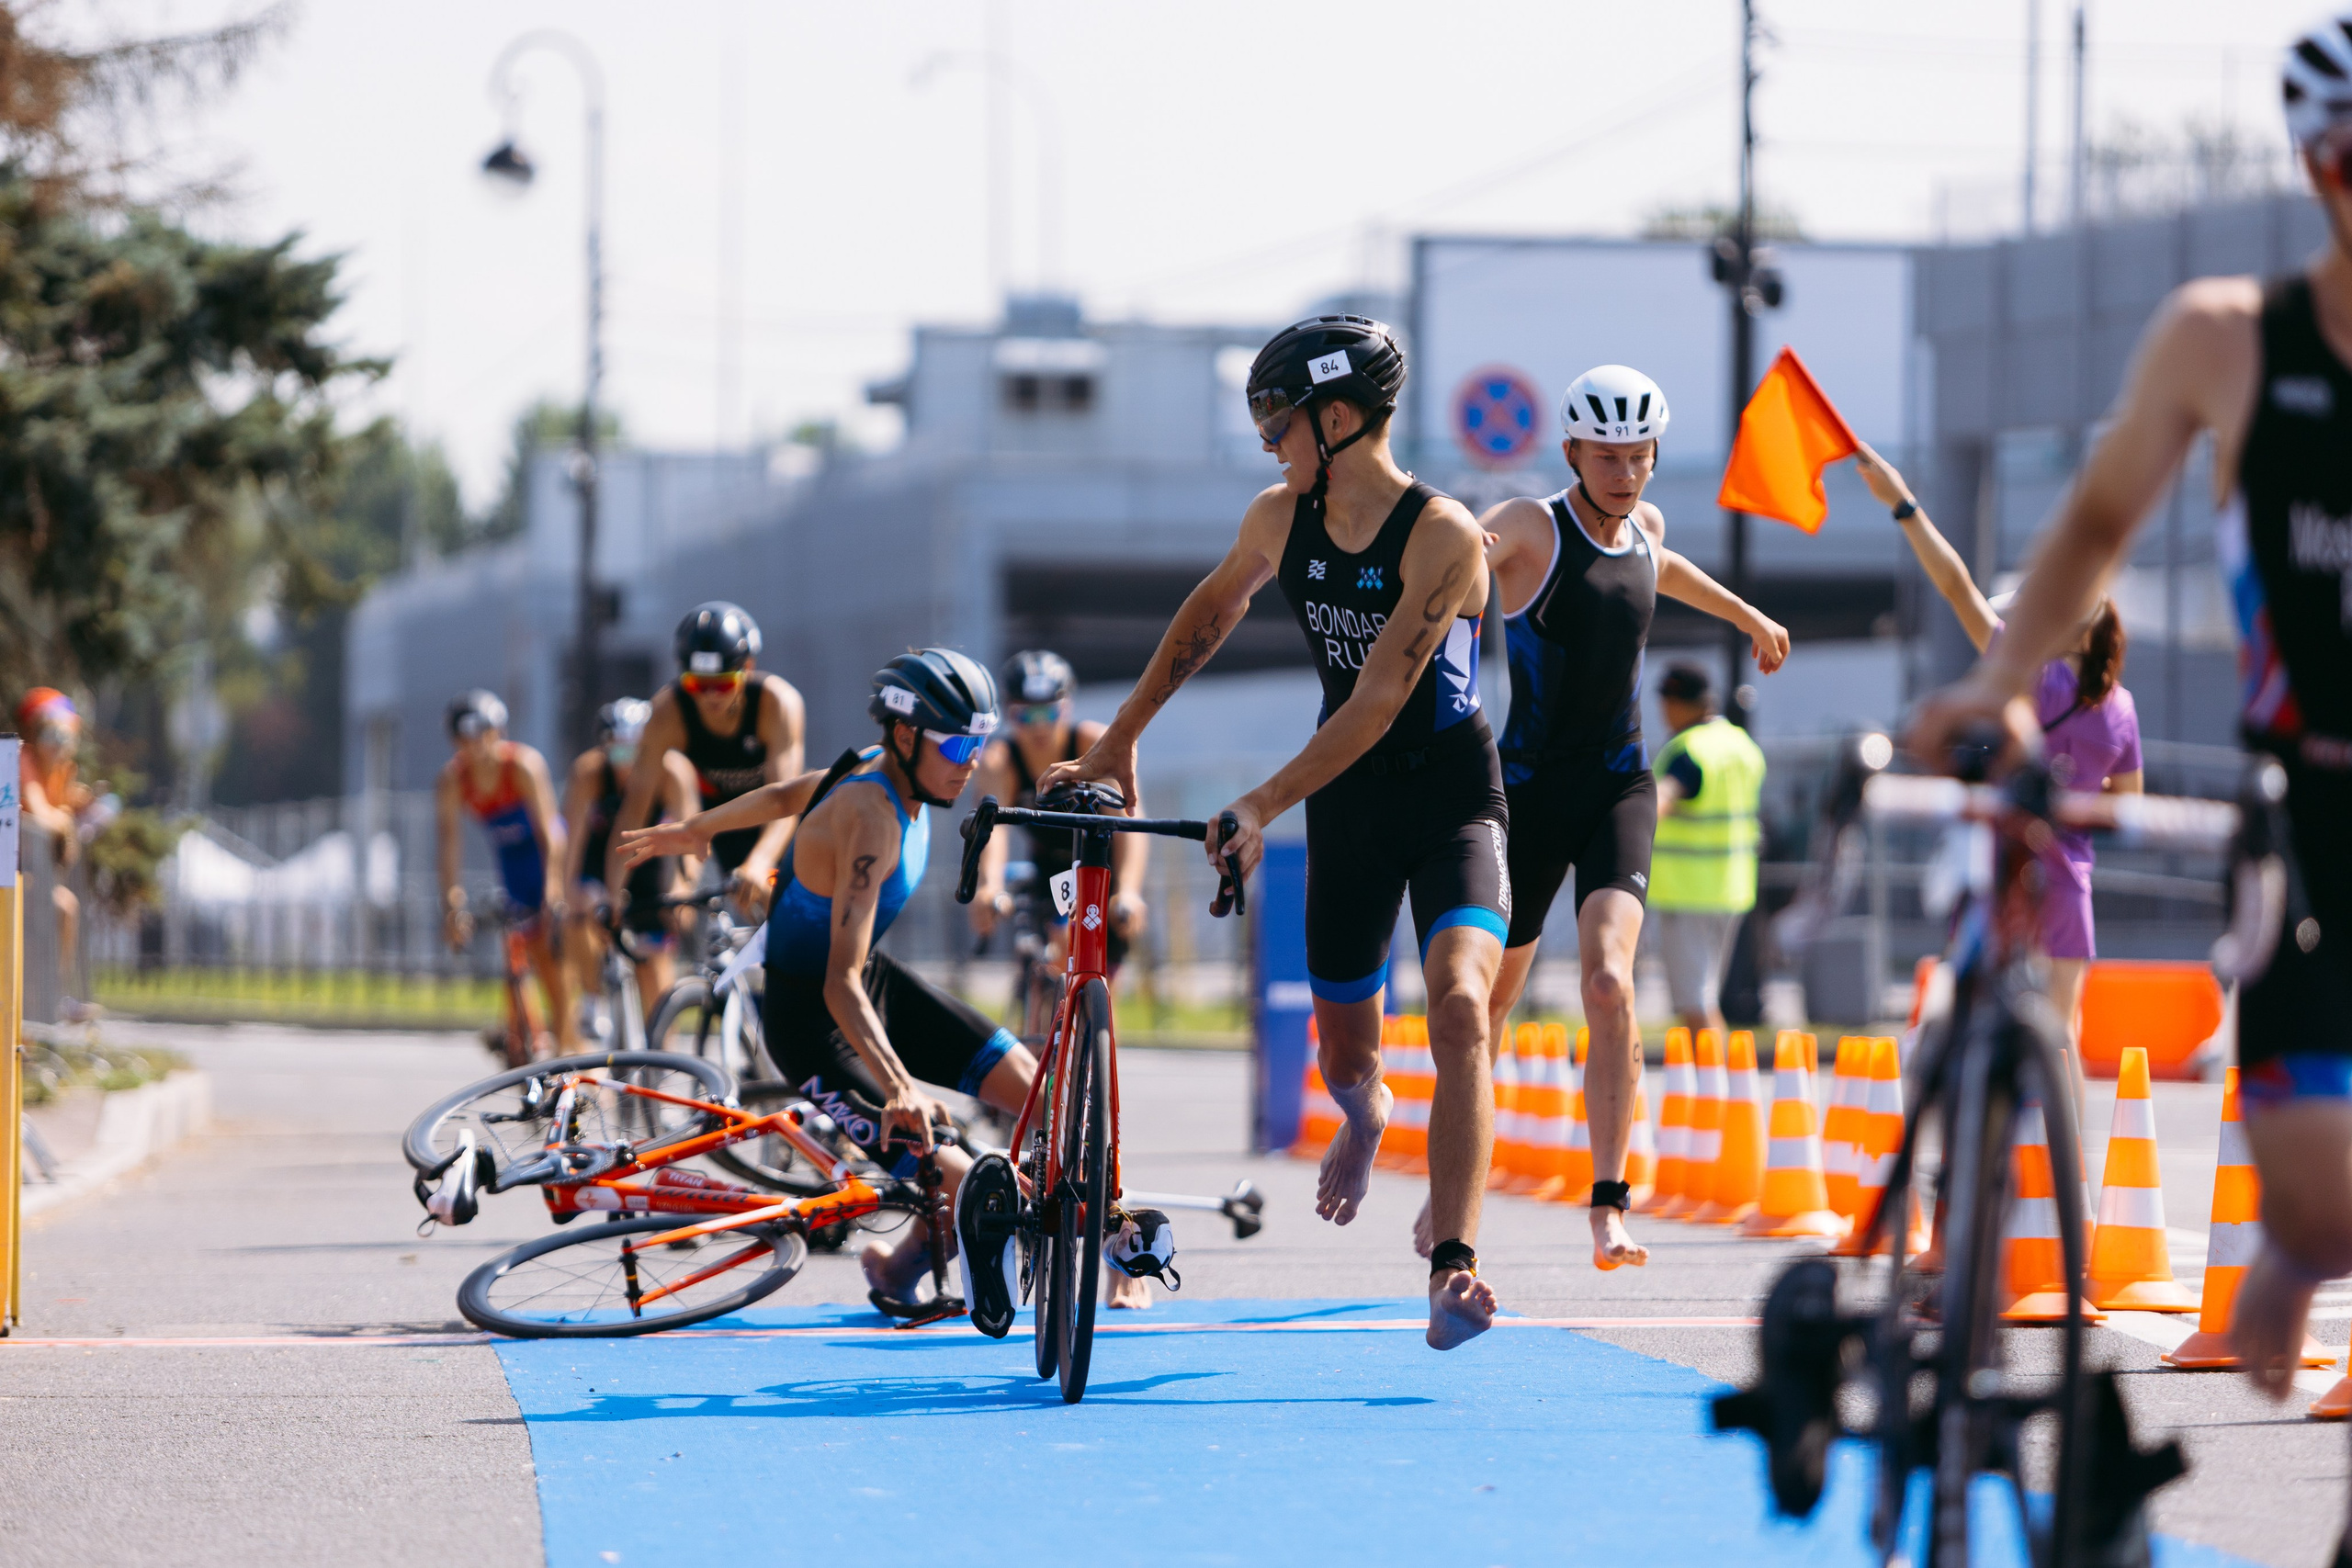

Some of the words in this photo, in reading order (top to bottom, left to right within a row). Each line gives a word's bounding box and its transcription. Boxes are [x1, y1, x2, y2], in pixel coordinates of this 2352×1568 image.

[1320, 358, 1340, 375] 84
[1615, 425, 1629, 437] 91
[1324, 637, 1374, 670] RU
[1485, 818, 1509, 911] ПРИМОРСКИЙ
[841, 853, 878, 928] 81
[798, 1075, 876, 1145] MAKO
[668, 1171, 705, 1187] TITAN
